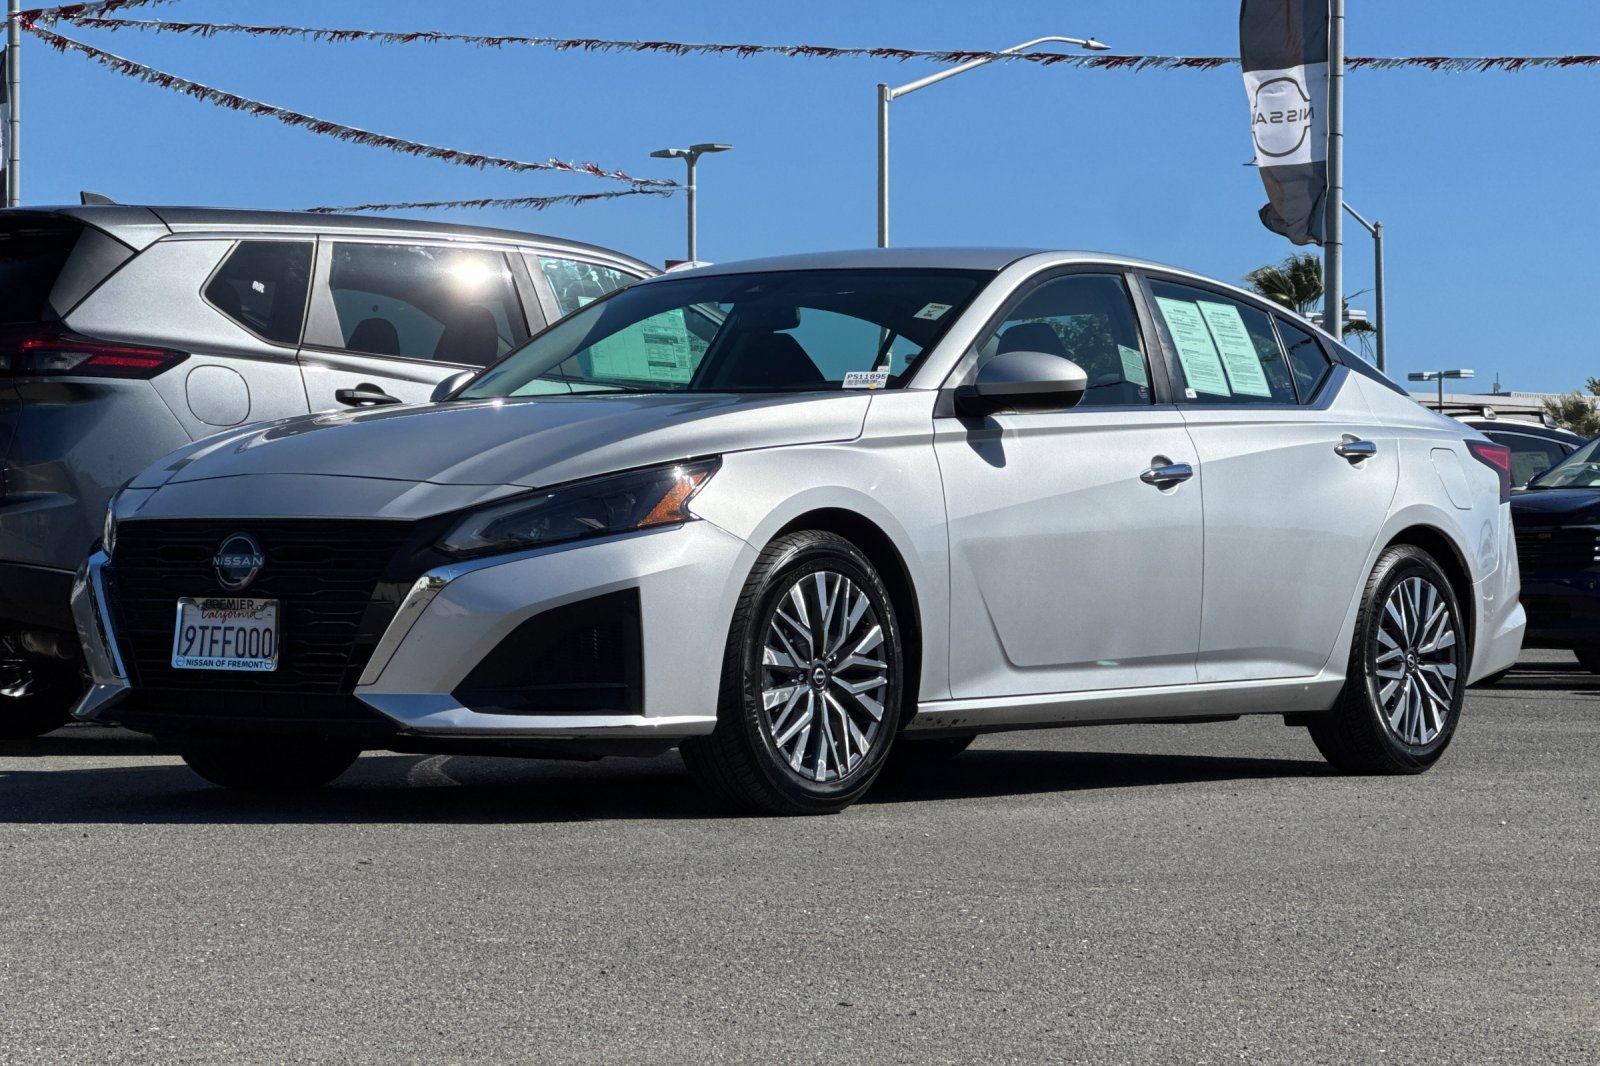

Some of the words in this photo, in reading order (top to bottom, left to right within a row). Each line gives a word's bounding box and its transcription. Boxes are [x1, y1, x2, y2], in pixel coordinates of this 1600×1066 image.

[212, 556, 263, 566] NISSAN
[205, 599, 254, 610] PREMIER
[201, 608, 259, 624] California
[183, 625, 273, 658] 9TFF000
[186, 658, 214, 667] NISSAN
[227, 660, 264, 668] FREMONT
